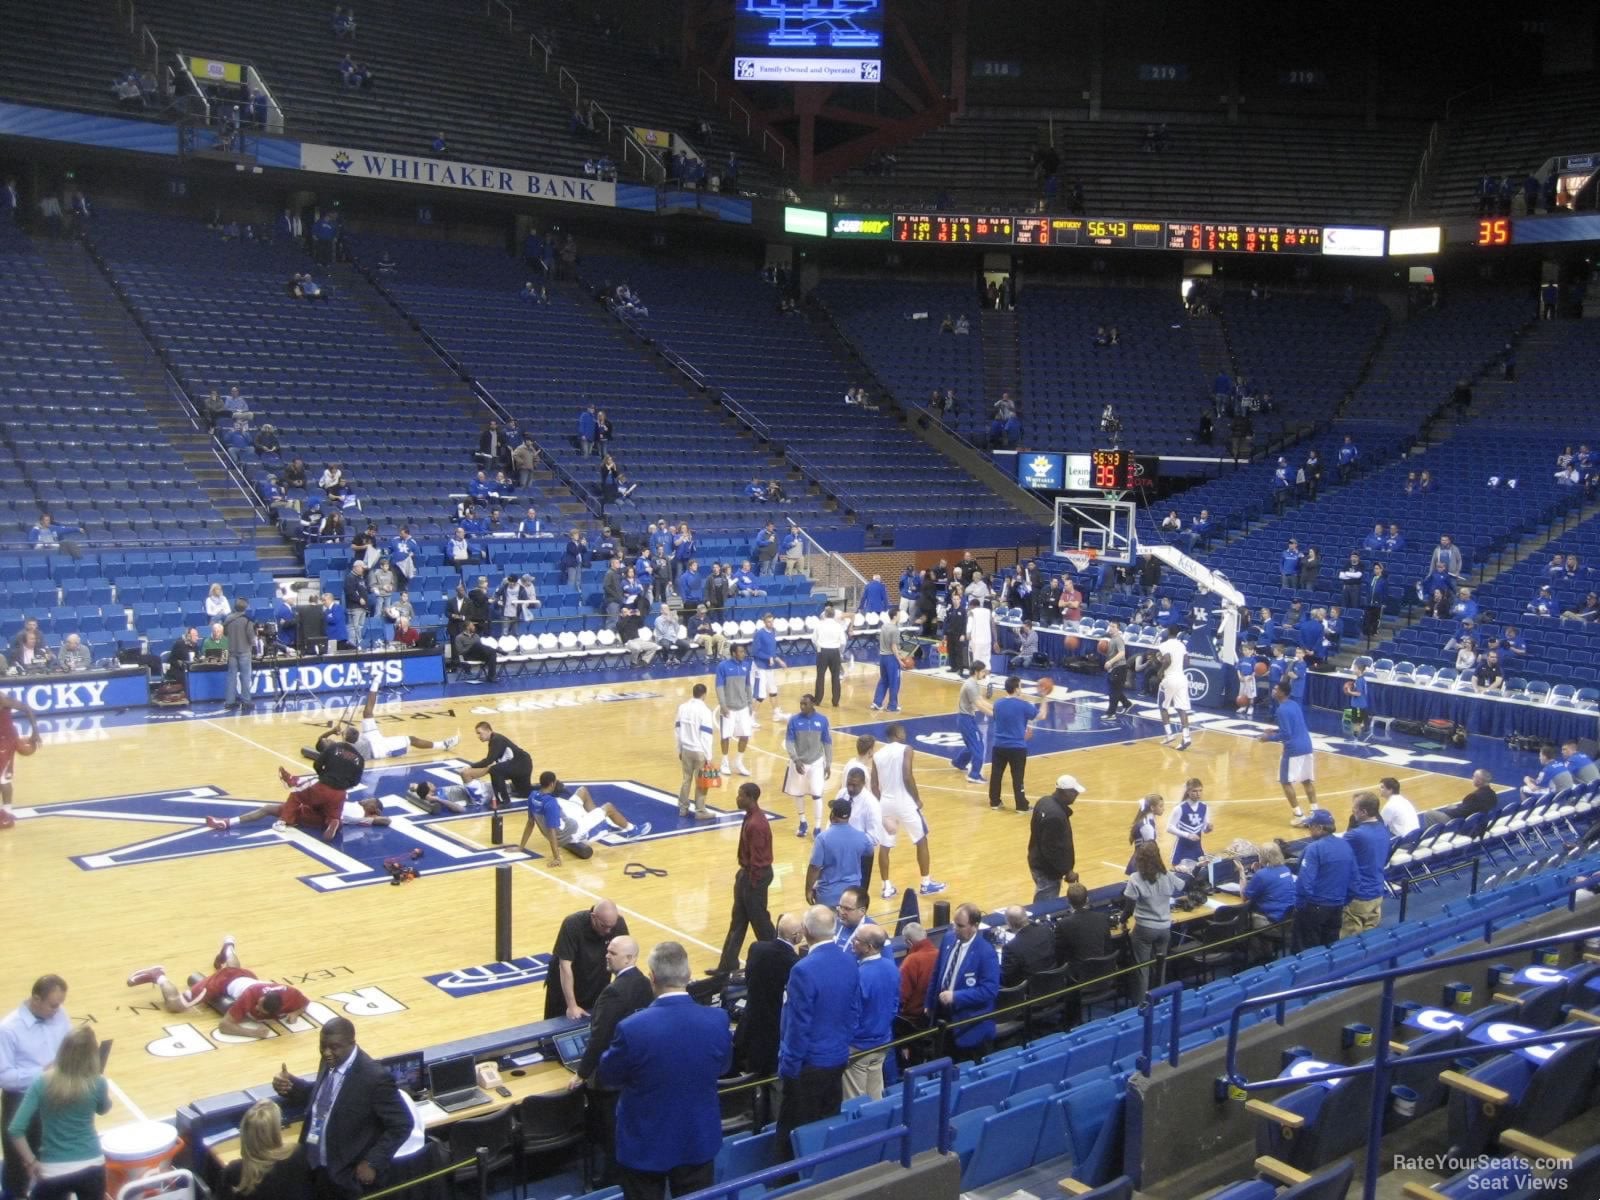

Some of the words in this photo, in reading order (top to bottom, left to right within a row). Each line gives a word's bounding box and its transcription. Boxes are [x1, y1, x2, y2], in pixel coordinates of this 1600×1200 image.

[760, 66, 782, 74] Family
[824, 66, 856, 74] Operated
[984, 64, 1009, 75] 218
[1152, 67, 1176, 79] 219
[362, 155, 514, 191] WHITAKER
[527, 175, 595, 201] BANK
[834, 220, 890, 233] SUBWAY
[918, 223, 930, 231] 20
[952, 224, 957, 232] 3
[976, 225, 987, 234] 30
[1040, 220, 1048, 231] 5
[1088, 222, 1126, 237] 56:43
[1192, 225, 1200, 236] 5
[918, 232, 930, 240] 21
[1226, 233, 1238, 241] 20
[1479, 221, 1506, 244] 35
[1040, 233, 1047, 244] 0
[1192, 238, 1200, 248] 0
[1284, 235, 1296, 243] 25
[1310, 236, 1319, 244] 11
[1218, 242, 1224, 250] 4
[1232, 242, 1238, 250] 4
[1093, 452, 1120, 465] 56:43
[1096, 466, 1114, 486] 35
[1188, 813, 1202, 826] UK
